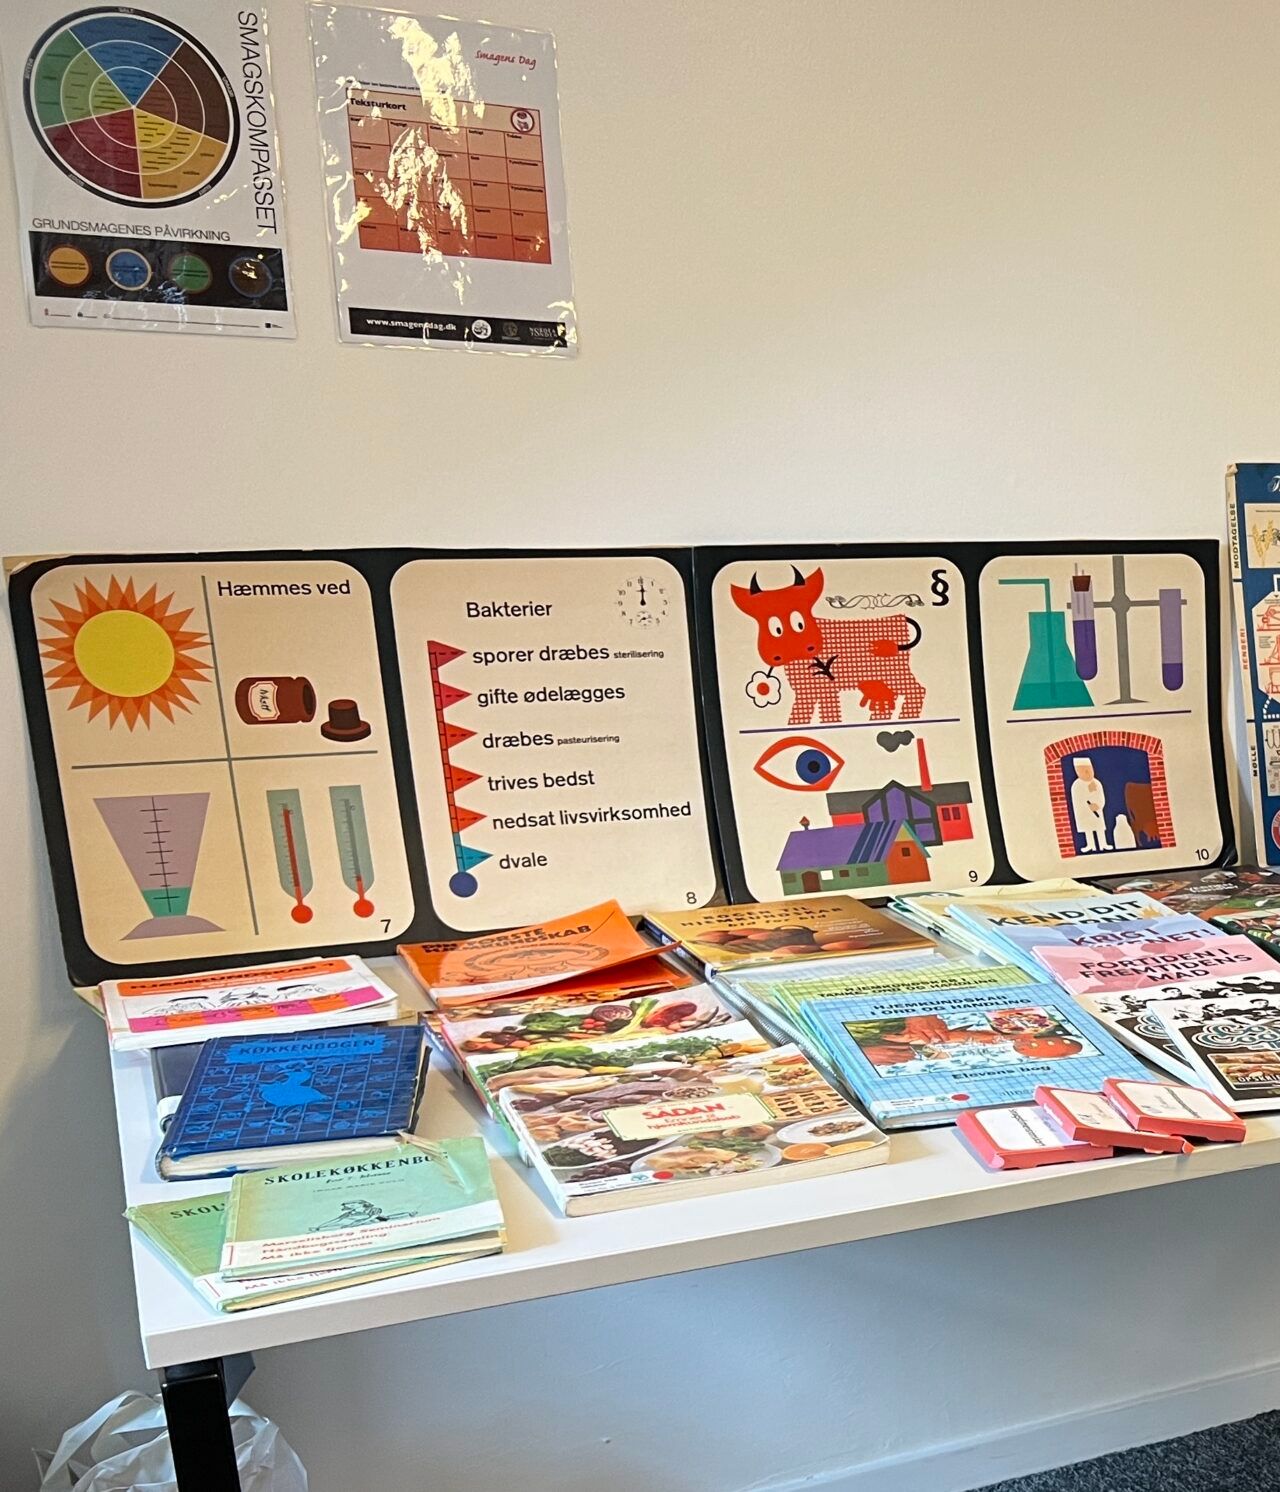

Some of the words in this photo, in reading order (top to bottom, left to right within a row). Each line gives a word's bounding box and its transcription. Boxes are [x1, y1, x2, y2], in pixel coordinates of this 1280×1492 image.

[476, 50, 515, 65] Smagens
[518, 53, 537, 69] Dag
[350, 97, 406, 112] Teksturkort
[238, 11, 277, 234] SMAGSKOMPASSET
[32, 217, 151, 236] GRUNDSMAGENES
[155, 221, 231, 242] PÅVIRKNING
[1229, 503, 1240, 570] MODTAGELSE
[217, 580, 312, 597] Hæmmes
[317, 580, 351, 595] ved
[930, 569, 950, 607] §
[467, 602, 552, 618] Bakterier
[473, 650, 534, 666] sporer
[539, 646, 610, 661] dræbes
[614, 650, 664, 660] sterilisering
[1240, 628, 1249, 670] RENSERI
[478, 688, 518, 707] gifte
[524, 685, 625, 704] ødelægges
[482, 732, 554, 748] dræbes
[557, 734, 620, 746] pasteurisering
[488, 775, 538, 791] trives
[543, 771, 595, 787] bedst
[493, 812, 556, 829] nedsat
[559, 802, 691, 825] livsvirksomhed
[499, 853, 548, 869] dvale
[1194, 849, 1210, 861] 10
[968, 870, 979, 884] 9
[686, 892, 697, 904] 8
[989, 909, 1086, 927] KEND
[1088, 900, 1144, 915] DIT
[380, 919, 392, 934] 7
[1069, 929, 1138, 947] KRIG
[1145, 928, 1162, 936] I
[1080, 954, 1252, 980] FREMTIDENS
[1081, 951, 1219, 970] FORTIDEN
[1219, 947, 1231, 956] I
[930, 978, 998, 989] HANDLING
[1143, 968, 1210, 983] MAD
[874, 995, 1008, 1010] HJEMKUNDSKAB
[951, 999, 1031, 1010] HANDLING
[239, 1039, 376, 1055] KØKKENBOGEN
[952, 1068, 1015, 1080] Elevens
[1020, 1064, 1051, 1073] bog
[264, 1152, 448, 1185] SKOLEKØKKENB
[170, 1203, 225, 1219] SKOL
